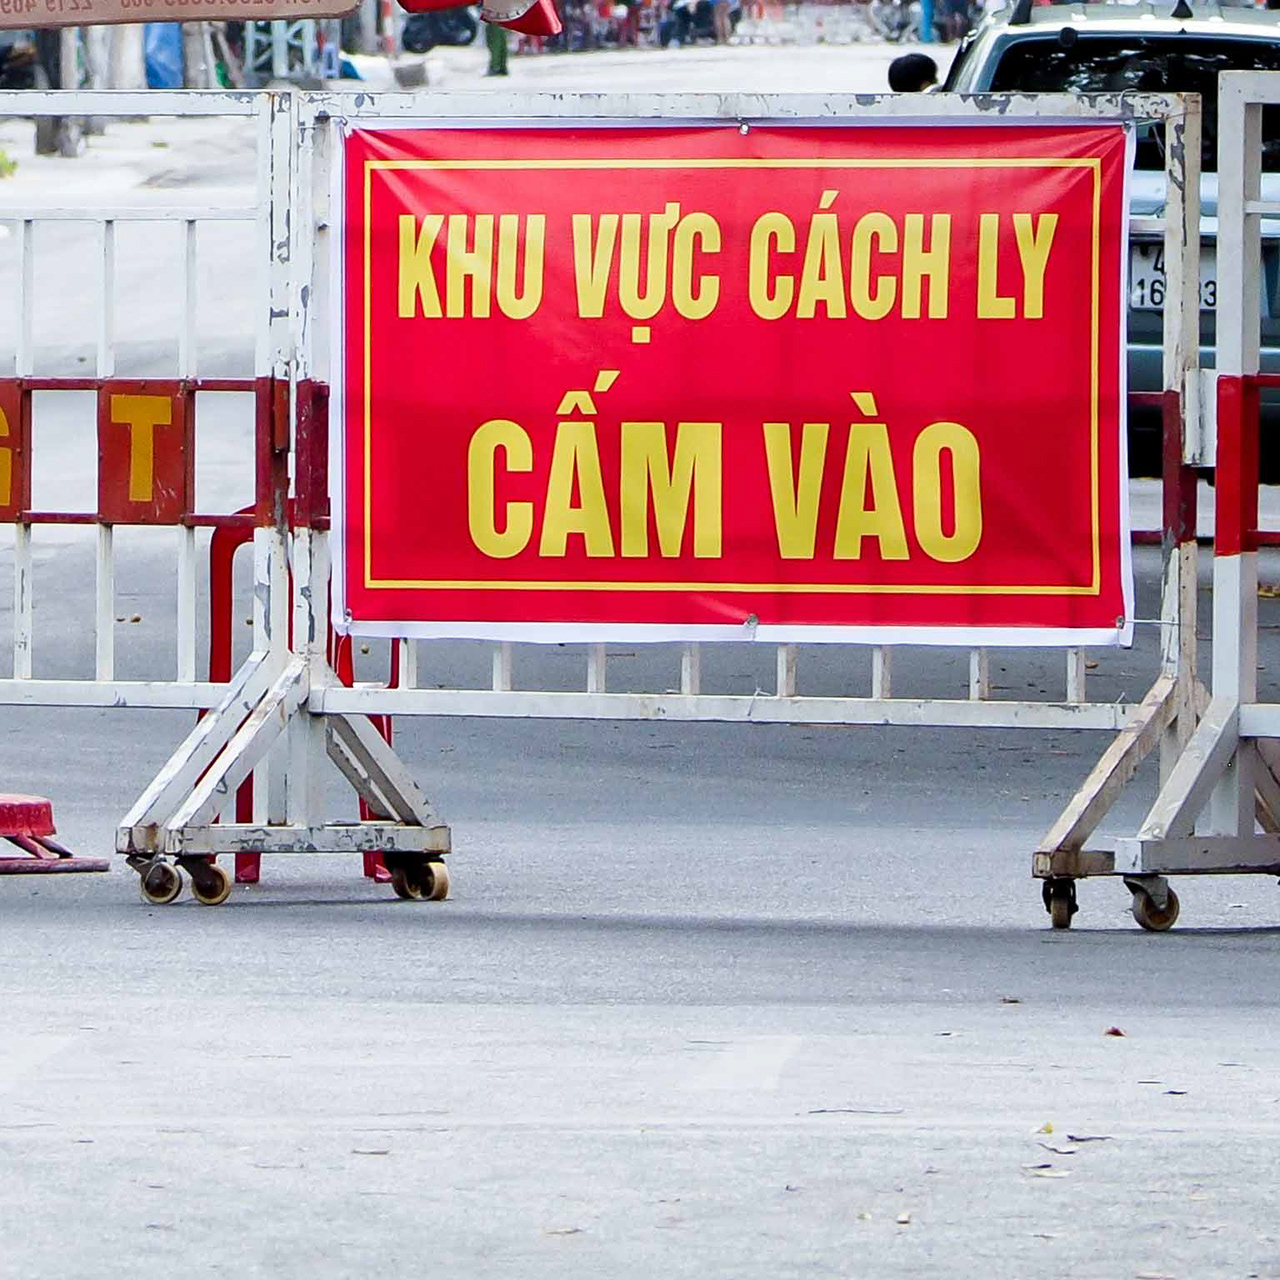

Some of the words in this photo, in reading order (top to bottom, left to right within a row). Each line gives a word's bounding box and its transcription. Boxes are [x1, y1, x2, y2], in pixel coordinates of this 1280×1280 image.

[398, 213, 545, 319] KHU
[572, 201, 721, 345] VỰC
[748, 189, 949, 320] CÁCH
[977, 212, 1059, 319] LY
[467, 369, 723, 559] CẤM
[763, 391, 984, 563] VÀO
